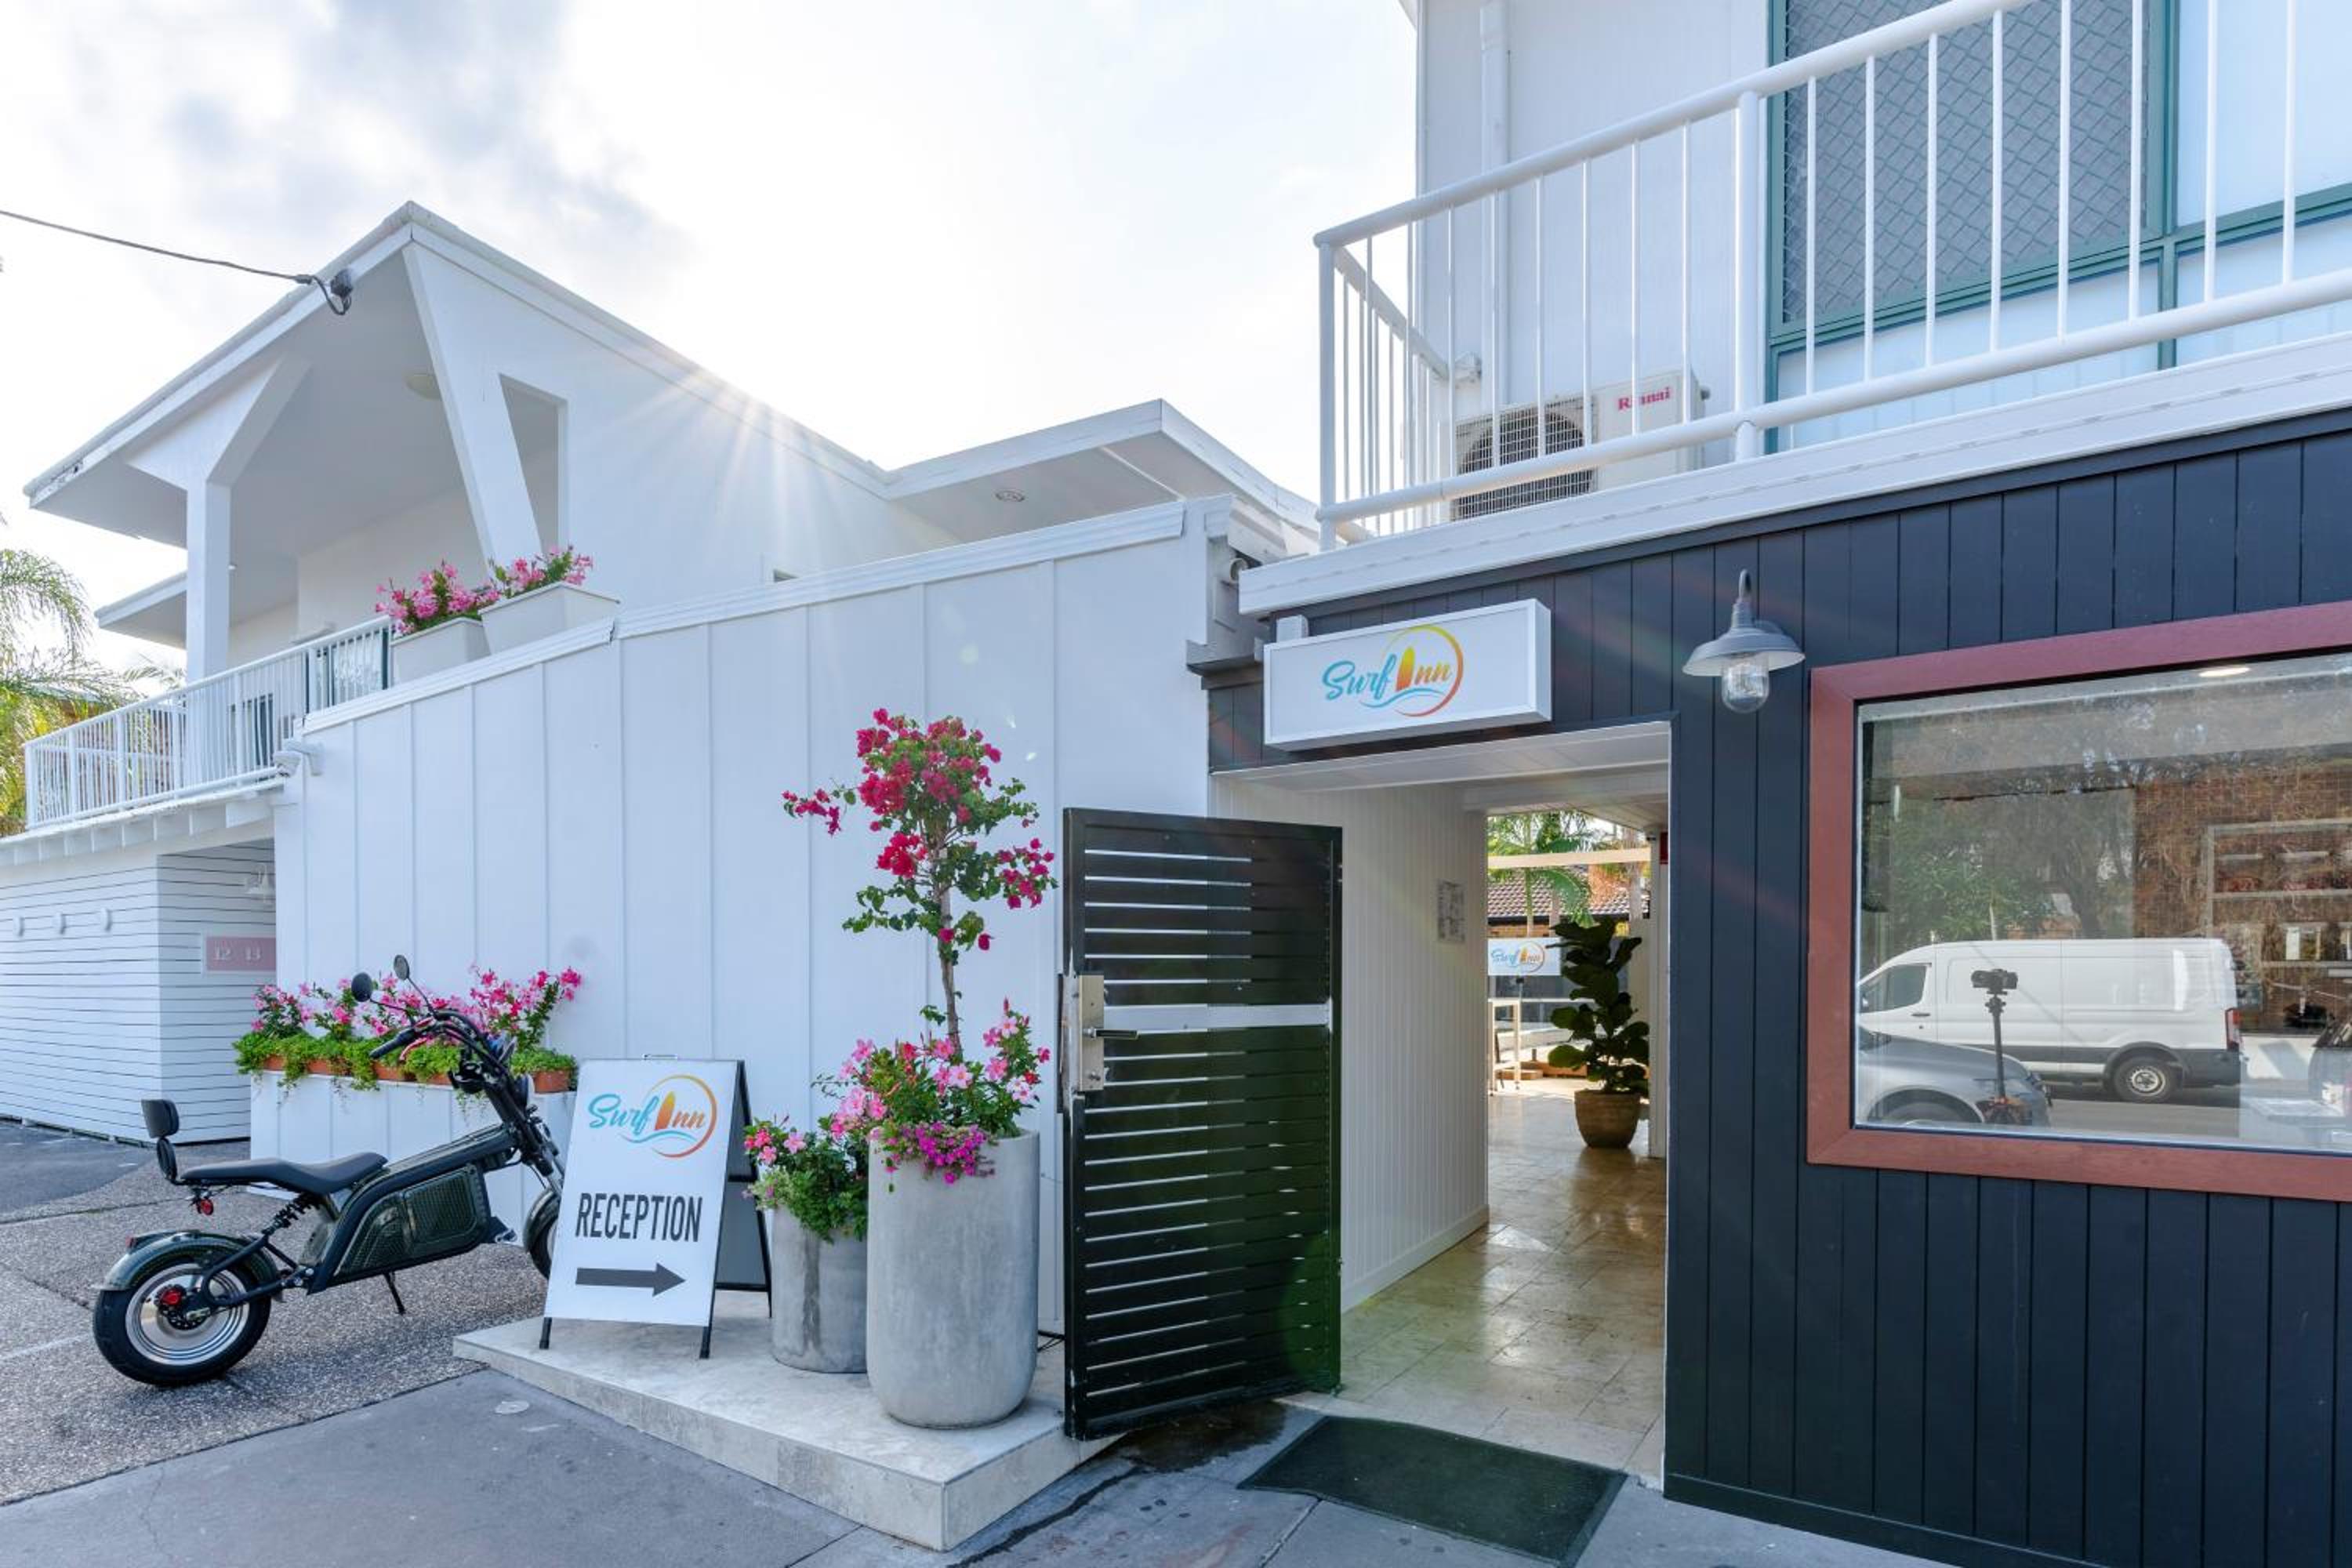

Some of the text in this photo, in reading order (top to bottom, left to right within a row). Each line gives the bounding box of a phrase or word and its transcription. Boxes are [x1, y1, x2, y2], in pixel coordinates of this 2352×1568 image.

[1322, 653, 1396, 700] Surf
[588, 1093, 659, 1135] Surf
[575, 1192, 702, 1242] RECEPTION
